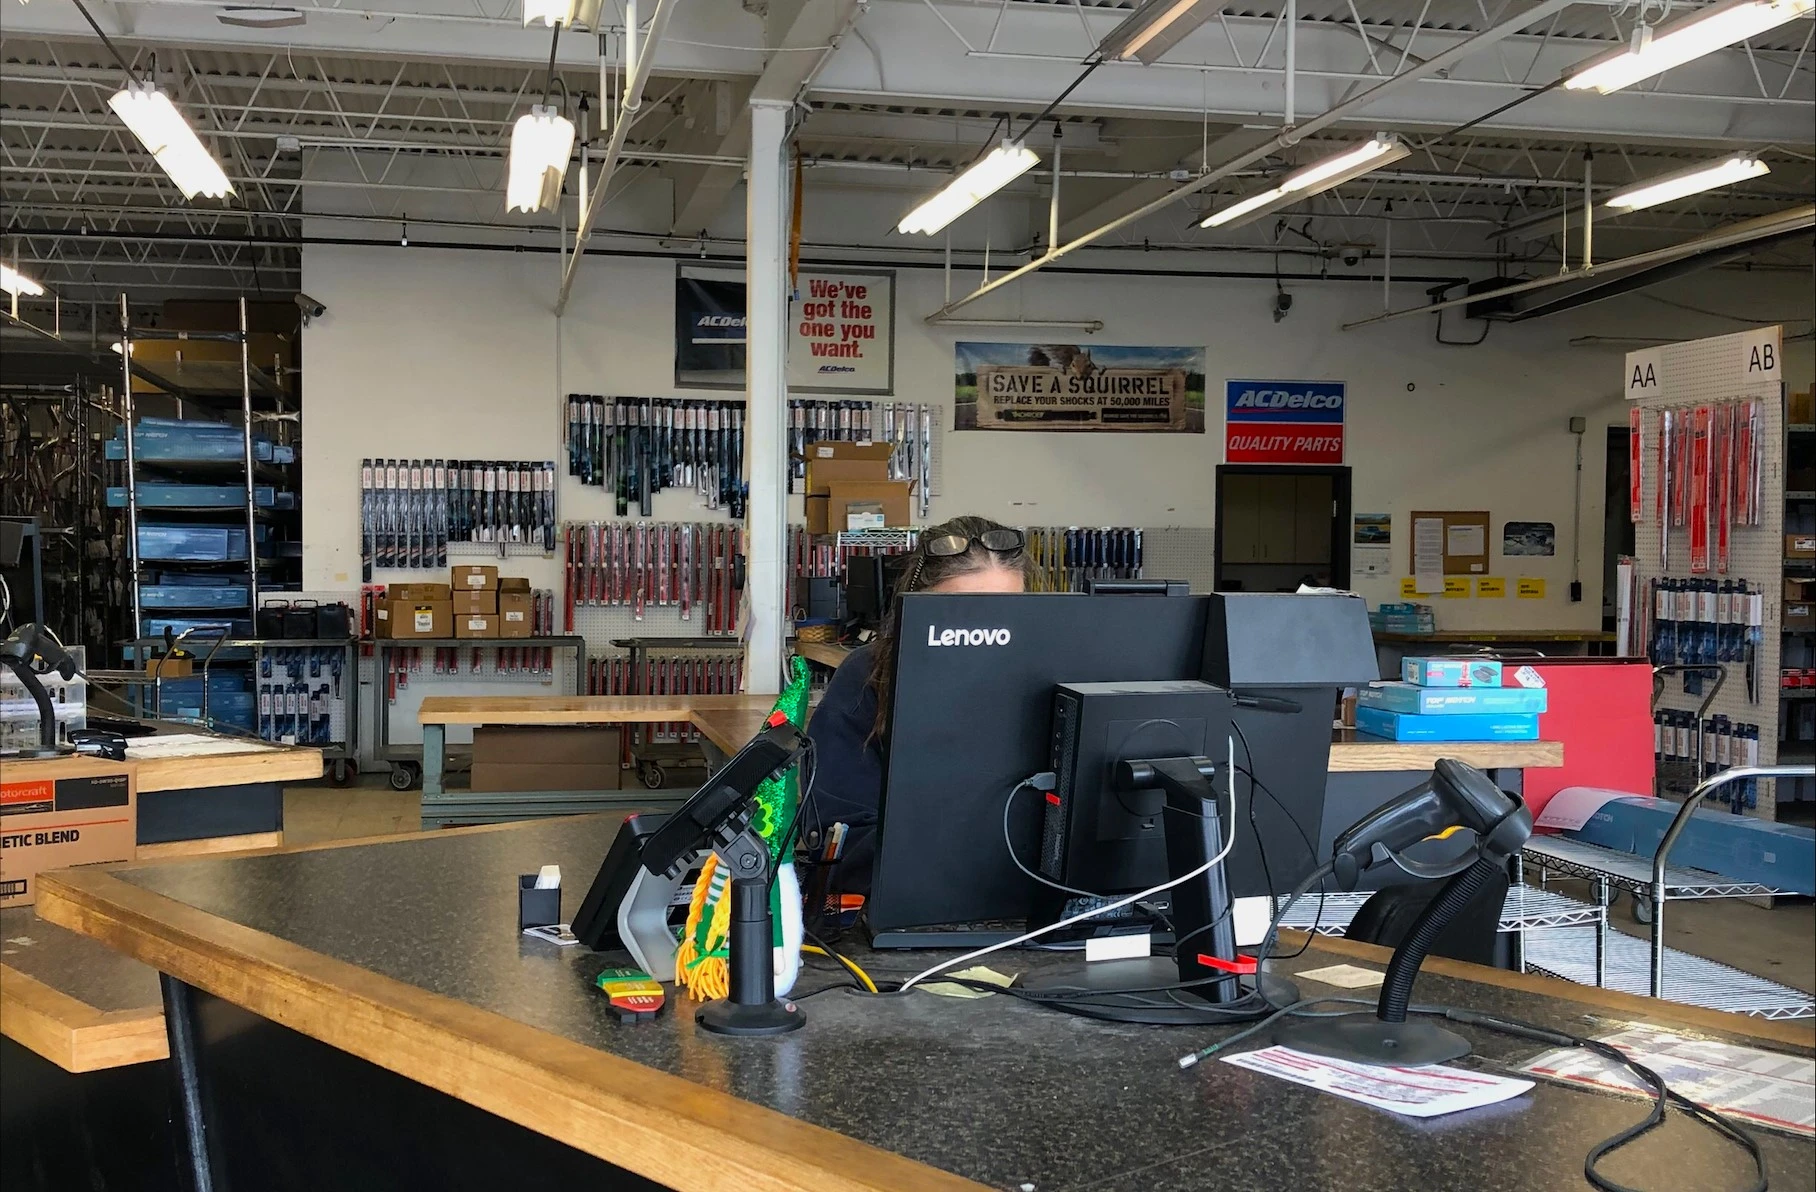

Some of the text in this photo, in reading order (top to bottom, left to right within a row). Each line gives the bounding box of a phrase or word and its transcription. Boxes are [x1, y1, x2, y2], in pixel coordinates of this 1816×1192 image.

[809, 279, 867, 299] We've
[803, 300, 872, 321] got the
[697, 315, 747, 327] ACDel
[800, 322, 875, 341] one you
[811, 340, 863, 358] want.
[1749, 343, 1774, 372] AB
[818, 365, 856, 373] ACDelco
[1631, 363, 1657, 389] AA
[993, 374, 1170, 395] SAVE A SQUIRREL
[993, 396, 1170, 407] REPLACE YOUR SHOCKS AT 50,000 MILES
[1234, 390, 1343, 408] ACDelco
[1229, 435, 1341, 451] QUALITY PARTS
[927, 624, 1011, 646] Lenovo
[1, 829, 80, 849] ETIC BLEND
